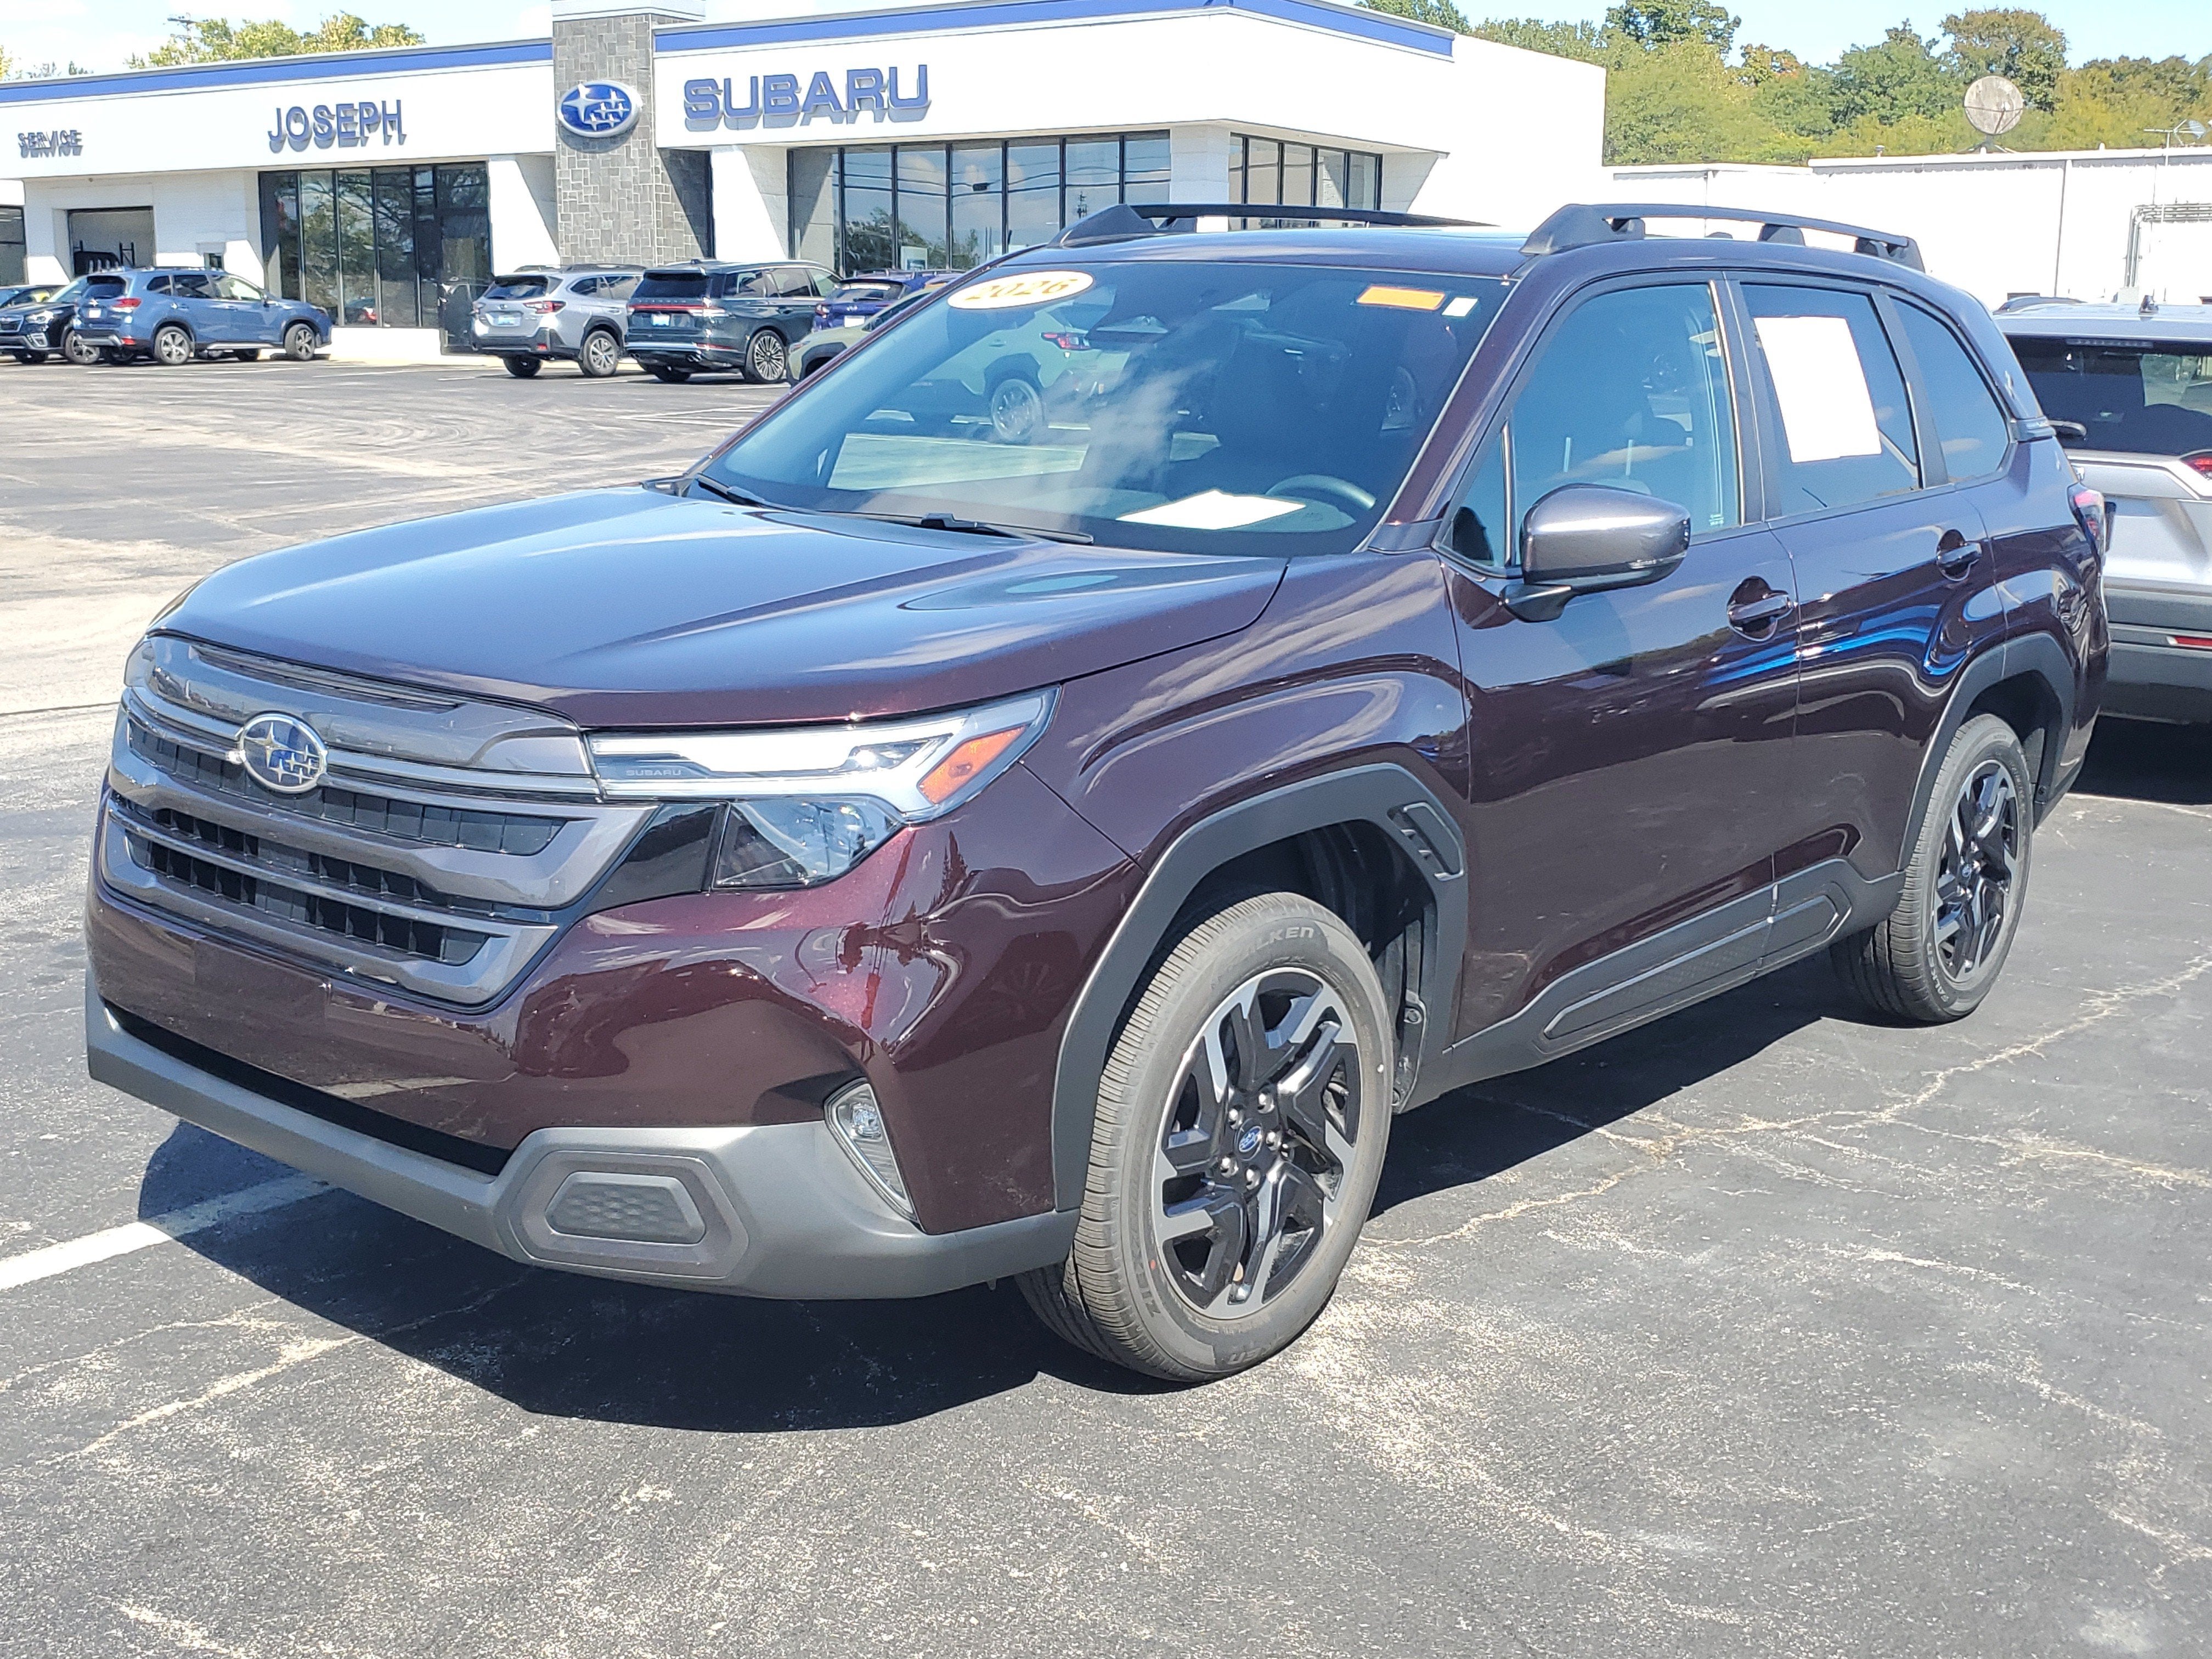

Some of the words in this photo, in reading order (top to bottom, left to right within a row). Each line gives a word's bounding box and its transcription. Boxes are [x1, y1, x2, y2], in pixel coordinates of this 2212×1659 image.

[684, 64, 929, 120] SUBARU
[268, 99, 402, 142] JOSEPH
[18, 129, 78, 149] SERVICE
[964, 278, 1079, 302] 2026
